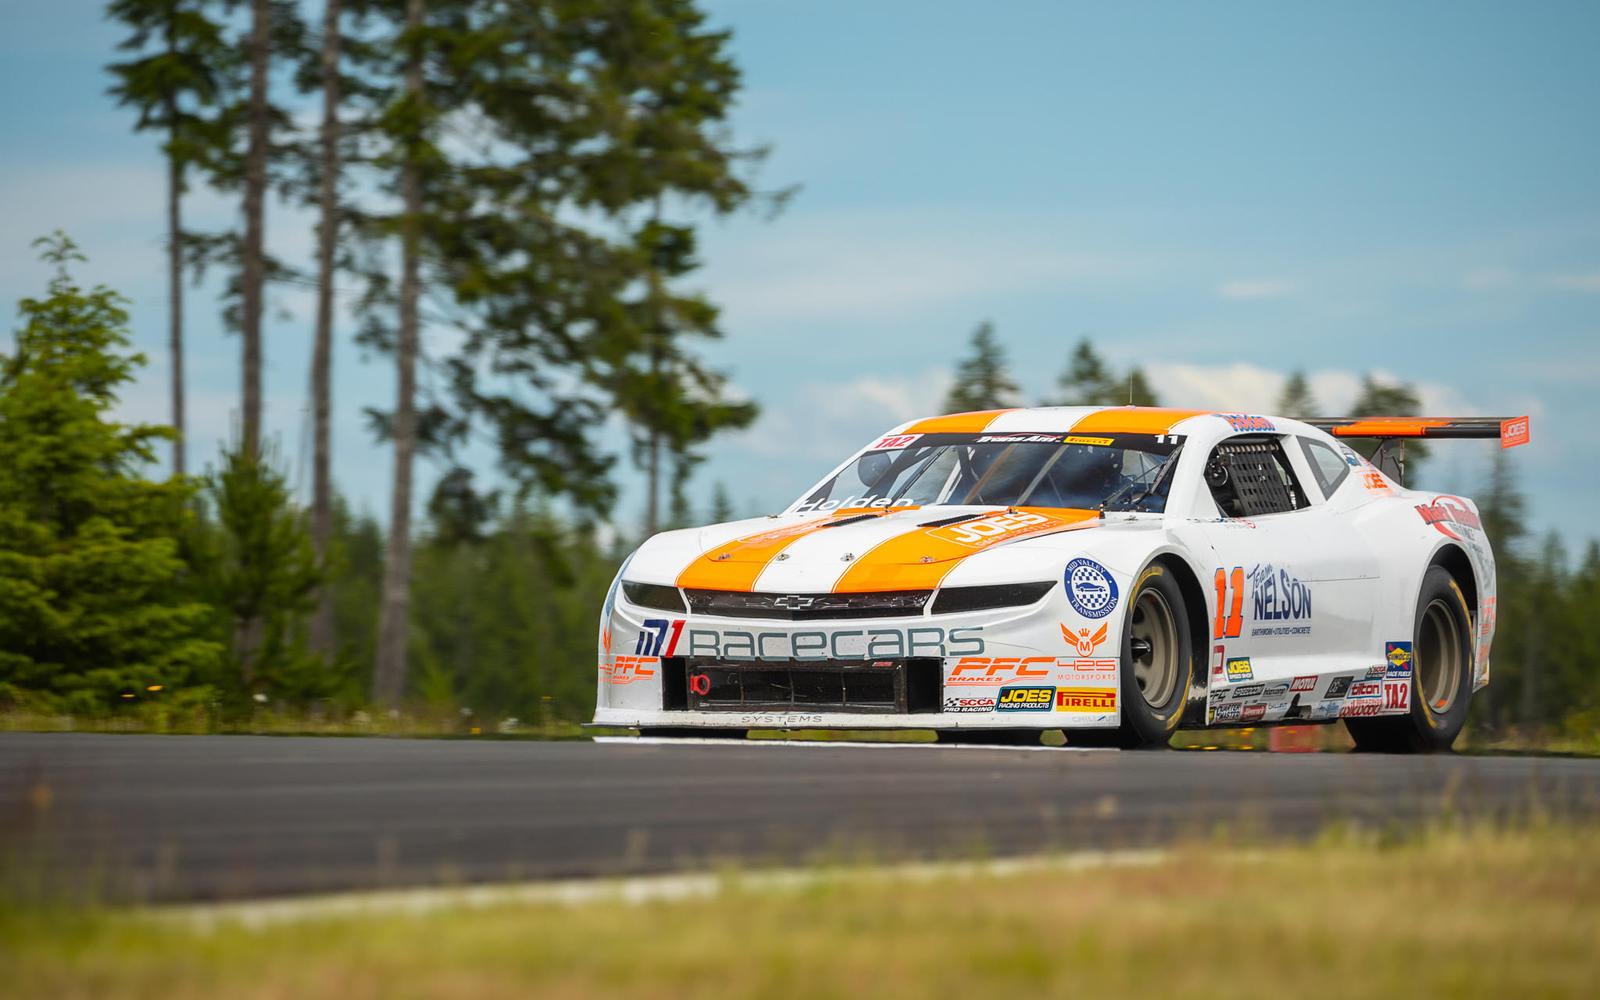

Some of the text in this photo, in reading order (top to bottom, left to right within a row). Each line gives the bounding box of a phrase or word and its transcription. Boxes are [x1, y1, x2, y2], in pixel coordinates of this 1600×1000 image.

[875, 435, 916, 449] TA2
[1153, 434, 1179, 445] 11
[796, 494, 914, 512] Holden
[950, 511, 1050, 543] JOES
[1066, 559, 1106, 574] MID VALLEY
[1253, 568, 1312, 620] NELSON
[1070, 596, 1118, 618] TRANSMISSION
[1213, 566, 1245, 640] 11
[613, 655, 659, 676] PFC
[951, 656, 1056, 676] PFC
[1056, 659, 1116, 672] 425
[1228, 660, 1251, 674] JOES
[1291, 678, 1316, 690] MOTUL
[959, 698, 995, 706] SCCA
[1000, 689, 1052, 703] JOES
[1056, 691, 1117, 708] PIRELLI
[1384, 683, 1408, 709] TA2
[742, 715, 823, 723] SYSTEMS
